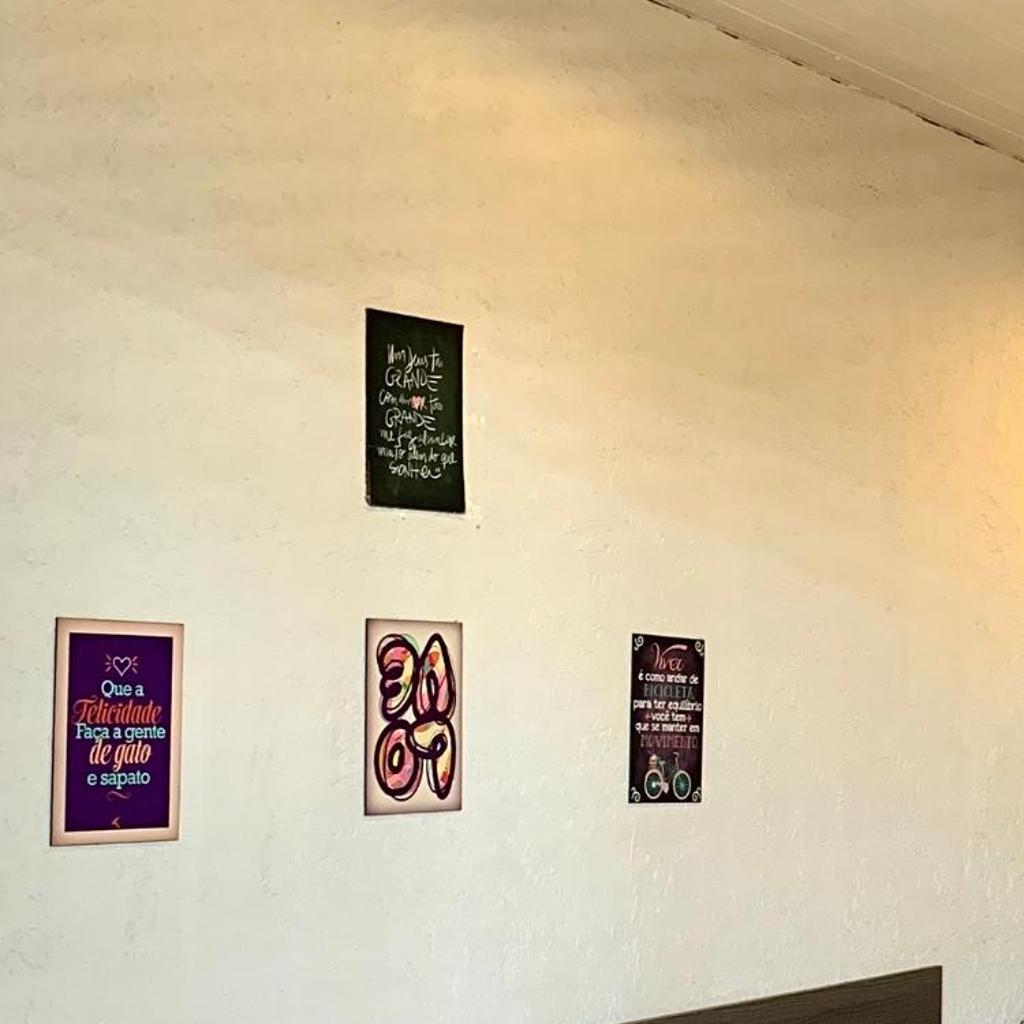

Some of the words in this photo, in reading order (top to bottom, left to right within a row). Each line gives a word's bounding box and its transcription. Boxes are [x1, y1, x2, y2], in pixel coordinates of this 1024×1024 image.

[385, 366, 444, 393] GRANDE
[645, 674, 665, 683] como
[666, 674, 688, 684] andar
[689, 675, 699, 685] de
[101, 680, 132, 698] Que
[135, 685, 144, 696] a
[74, 695, 162, 724] Felicidade
[633, 700, 651, 711] para
[654, 699, 666, 710] ter
[652, 710, 670, 721] você
[671, 712, 686, 722] tem
[75, 723, 110, 742] Faça
[113, 728, 122, 739] a
[124, 724, 166, 743] gente
[635, 723, 649, 734] que
[651, 723, 660, 732] se
[689, 724, 700, 733] em
[89, 739, 112, 766] de
[113, 741, 152, 771] gato
[87, 773, 97, 785] e
[100, 770, 151, 789] sapato
